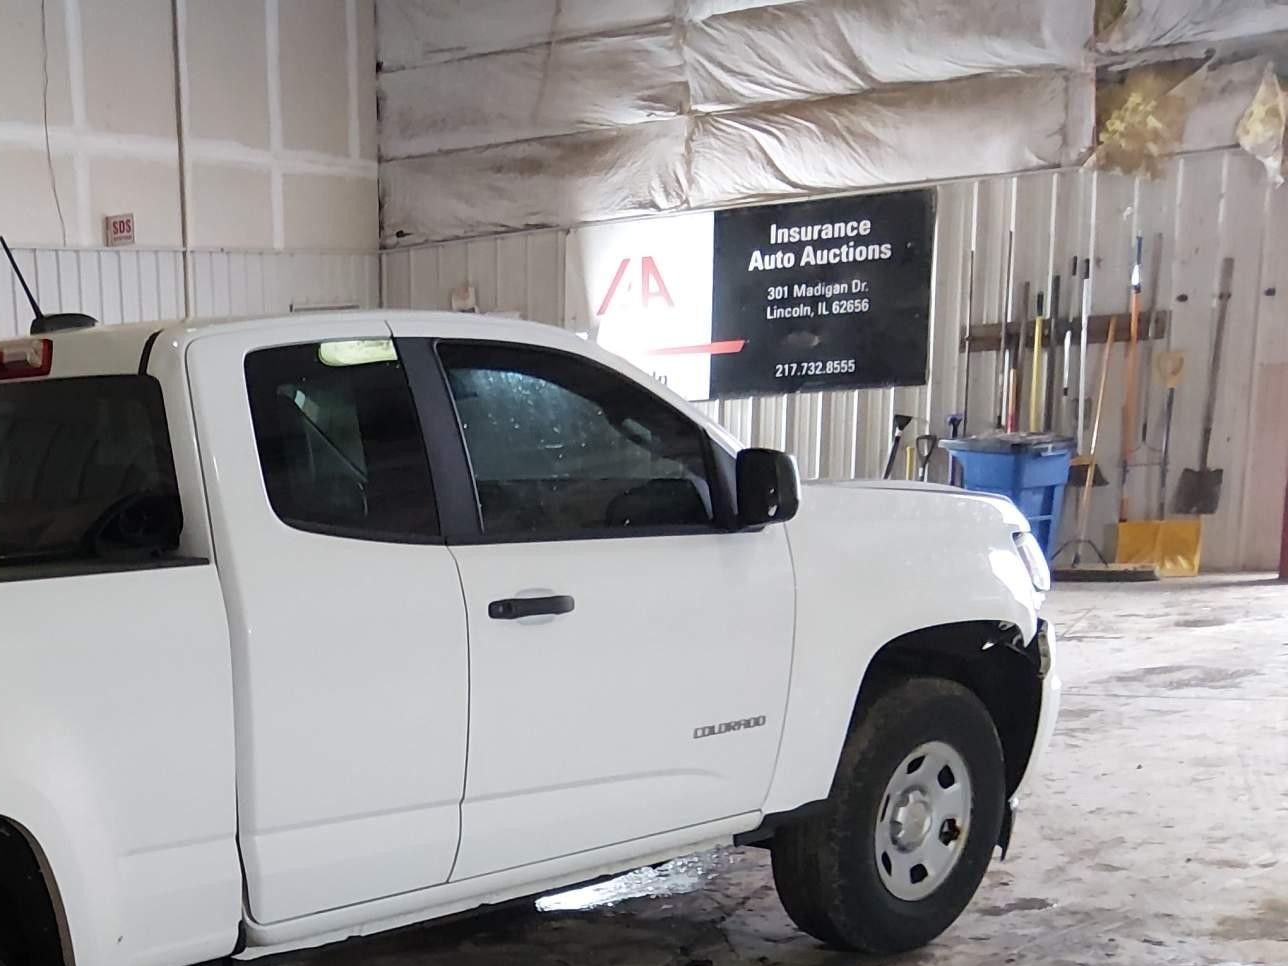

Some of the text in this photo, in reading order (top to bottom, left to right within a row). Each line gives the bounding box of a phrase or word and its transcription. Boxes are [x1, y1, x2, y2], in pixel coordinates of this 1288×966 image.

[113, 219, 131, 234] SDS
[770, 219, 872, 244] Insurance
[748, 242, 892, 272] Auto Auctions
[767, 279, 868, 300] 301 Madigan Dr.
[766, 298, 869, 320] Lincoln, IL 62656
[775, 360, 855, 377] 217.732.8555
[693, 715, 766, 739] COLORADO
